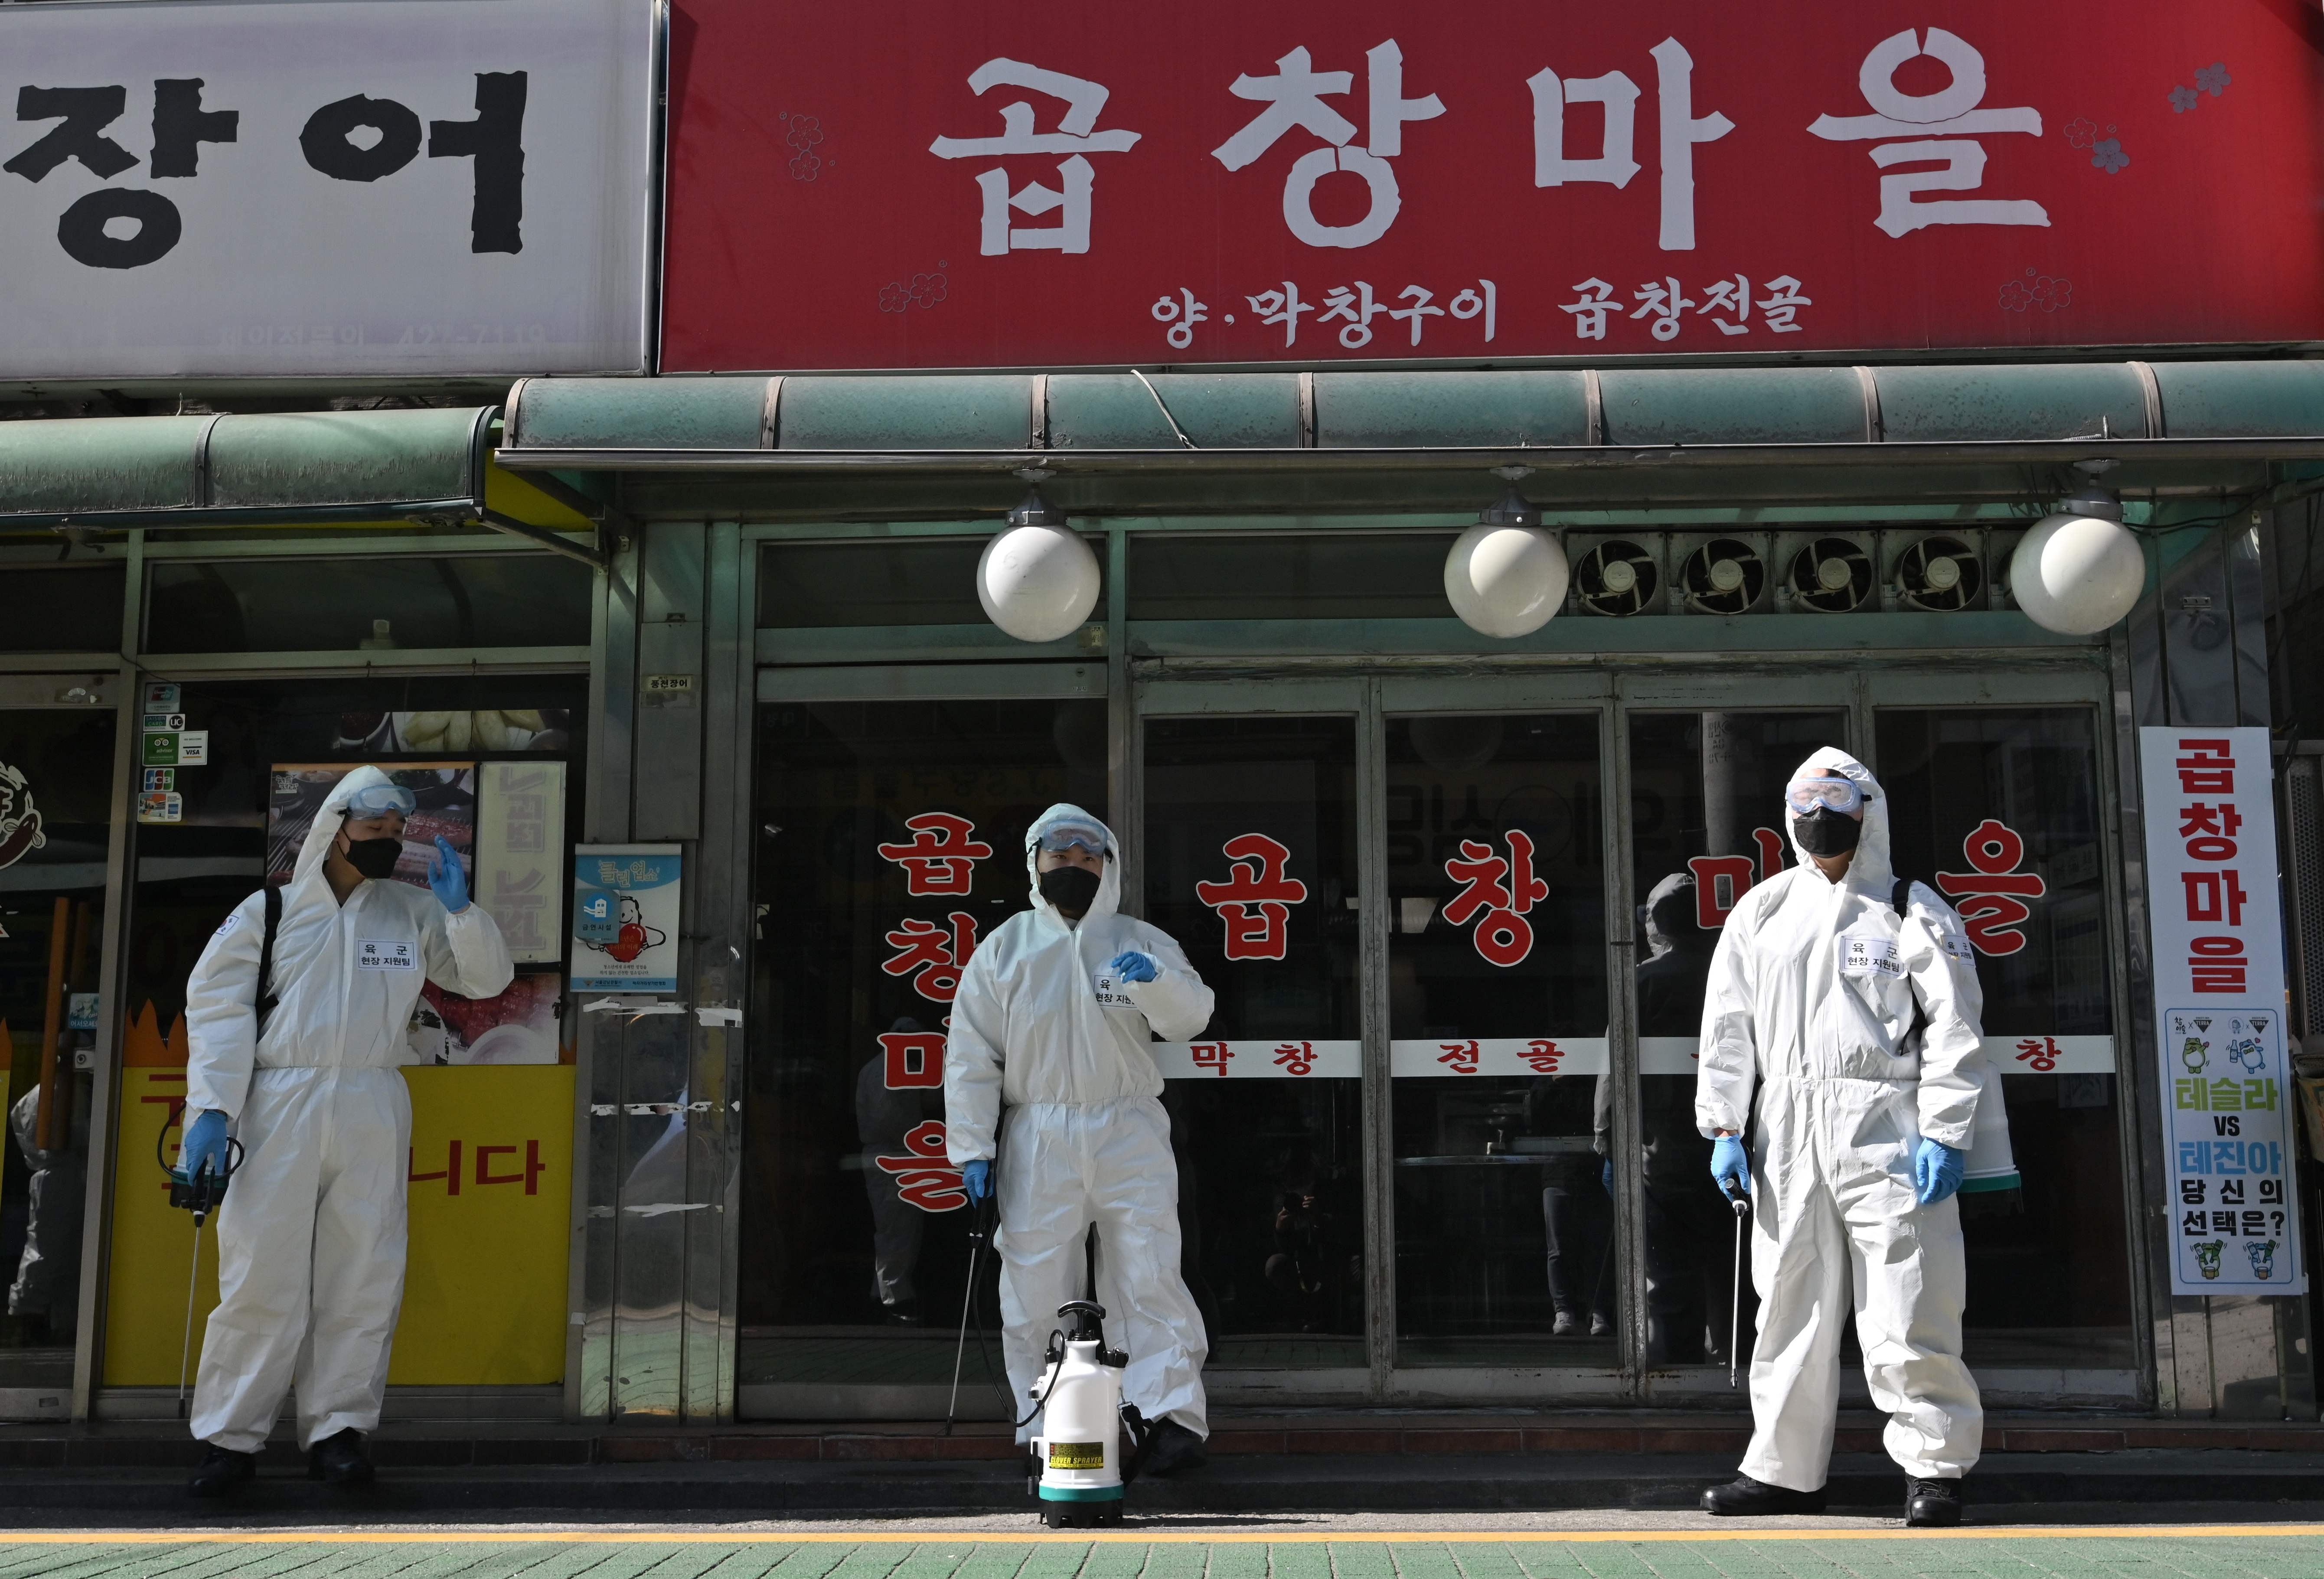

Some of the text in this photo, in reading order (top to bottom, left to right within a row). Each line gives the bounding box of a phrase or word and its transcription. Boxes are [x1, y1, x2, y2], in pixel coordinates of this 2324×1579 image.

[928, 26, 2051, 255] 곱창마을
[3, 70, 528, 269] 장어
[1558, 274, 1812, 341] 곱창전골
[651, 679, 688, 688] 풍천장어
[2176, 739, 2248, 993] 곱창마을
[361, 956, 410, 966] 현장 지원팀
[1847, 957, 1900, 972] 현장 지원팀
[1095, 993, 1135, 1005] 현장 지원
[2175, 1077, 2279, 1111] 테슬라
[2213, 1116, 2240, 1136] VS
[2178, 1141, 2282, 1175] 테진아
[2183, 1210, 2285, 1236] 선택은?
